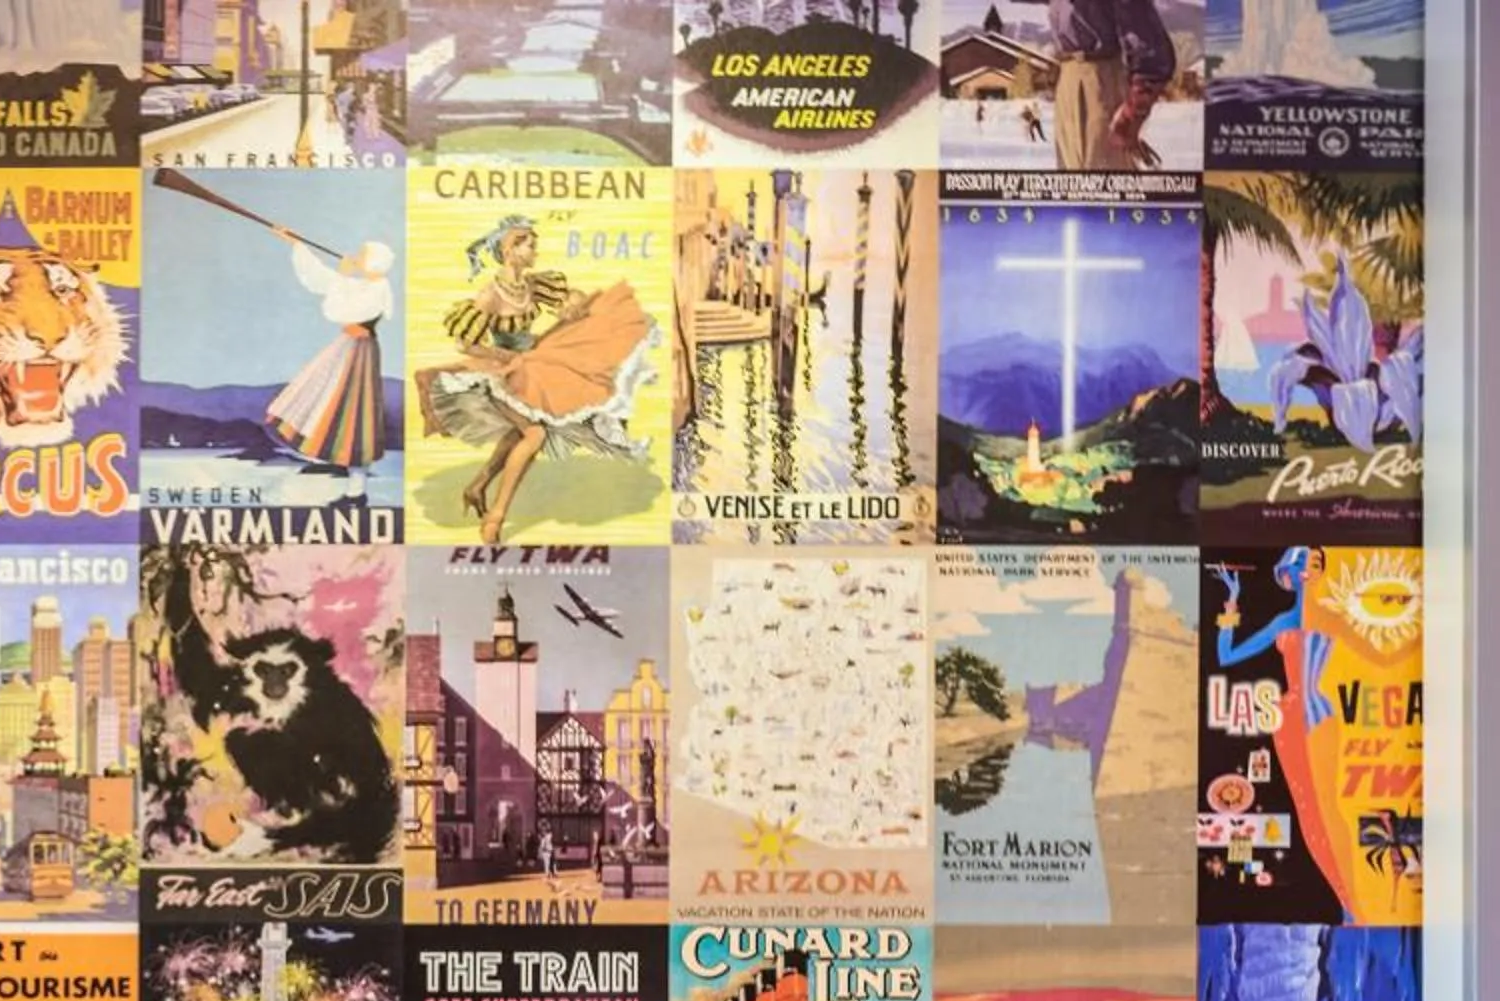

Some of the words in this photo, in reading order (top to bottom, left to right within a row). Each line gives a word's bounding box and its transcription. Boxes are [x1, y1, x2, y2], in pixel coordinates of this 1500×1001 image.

[711, 55, 759, 77] LOS
[766, 55, 871, 77] ANGELES
[731, 88, 855, 107] AMERICAN
[773, 110, 876, 128] AIRLINES
[1259, 106, 1412, 124] YELLOWSTONE
[15, 131, 117, 157] CANADA
[153, 154, 206, 168] SAN
[435, 170, 646, 199] CARIBBEAN
[25, 186, 132, 225] BARNUM
[57, 230, 133, 263] BAILEY
[566, 230, 657, 258] BOAC
[1202, 442, 1280, 458] DISCOVER
[1266, 455, 1358, 503] Puerto
[1359, 443, 1424, 488] Rico
[149, 487, 262, 504] SWEDEN
[705, 495, 784, 520] VENISE
[791, 503, 811, 520] ET
[819, 504, 841, 520] LE
[846, 495, 899, 520] LIDO
[151, 503, 397, 544] VÄRMLAND
[448, 547, 506, 564] FLY
[518, 546, 611, 564] TWA
[1207, 674, 1284, 735] LAS
[942, 832, 999, 857] FORT
[1004, 832, 1093, 858] MARION
[941, 860, 1003, 871] NATIONAL
[1008, 861, 1087, 872] MONUMENT
[700, 868, 909, 895] ARIZONA
[264, 872, 403, 919] SAS
[435, 899, 468, 925] TO
[475, 899, 598, 925] GERMANY
[677, 906, 753, 919] VACATION
[758, 906, 803, 919] STATE
[808, 906, 829, 919] OF
[833, 906, 863, 919] THE
[867, 906, 926, 918] NATION
[681, 926, 913, 978] CUNARD
[420, 951, 504, 993] THE
[513, 951, 639, 993] TRAIN
